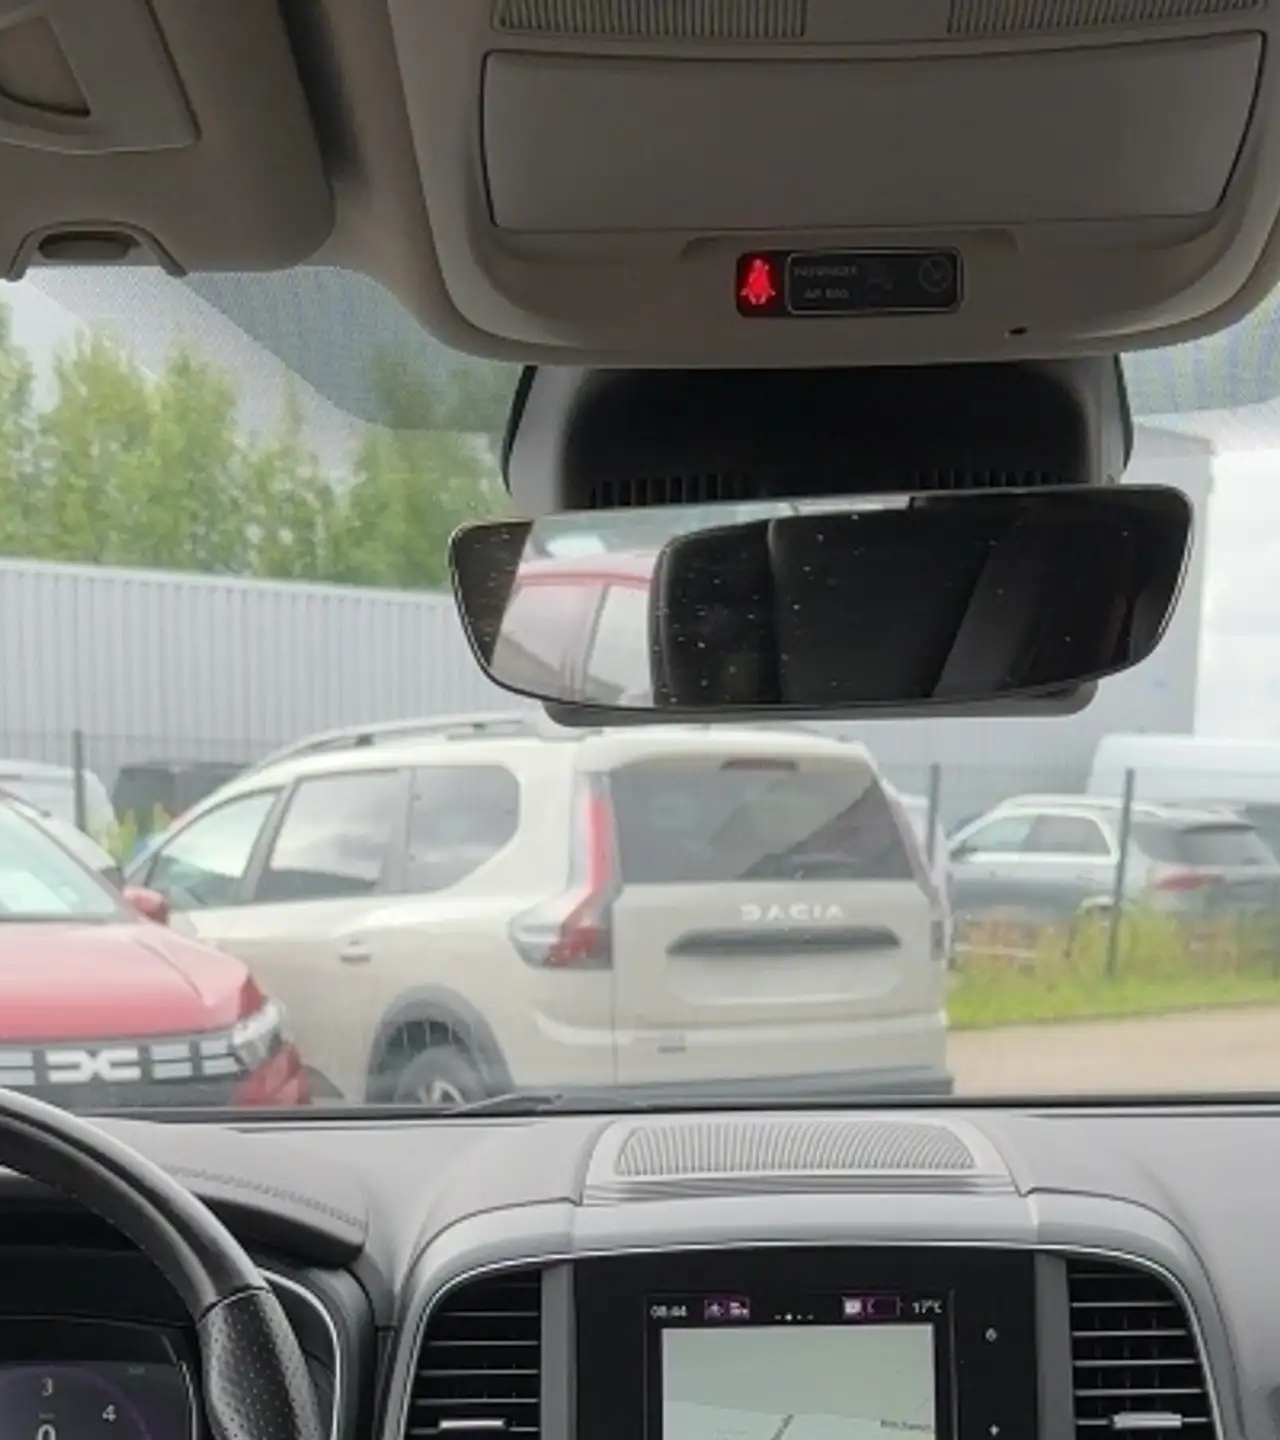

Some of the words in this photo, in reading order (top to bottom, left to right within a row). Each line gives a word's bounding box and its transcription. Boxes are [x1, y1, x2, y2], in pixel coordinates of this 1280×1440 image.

[739, 902, 846, 922] DACIA
[911, 1299, 943, 1315] 17°C
[41, 1376, 54, 1397] 3
[102, 1404, 117, 1422] 4
